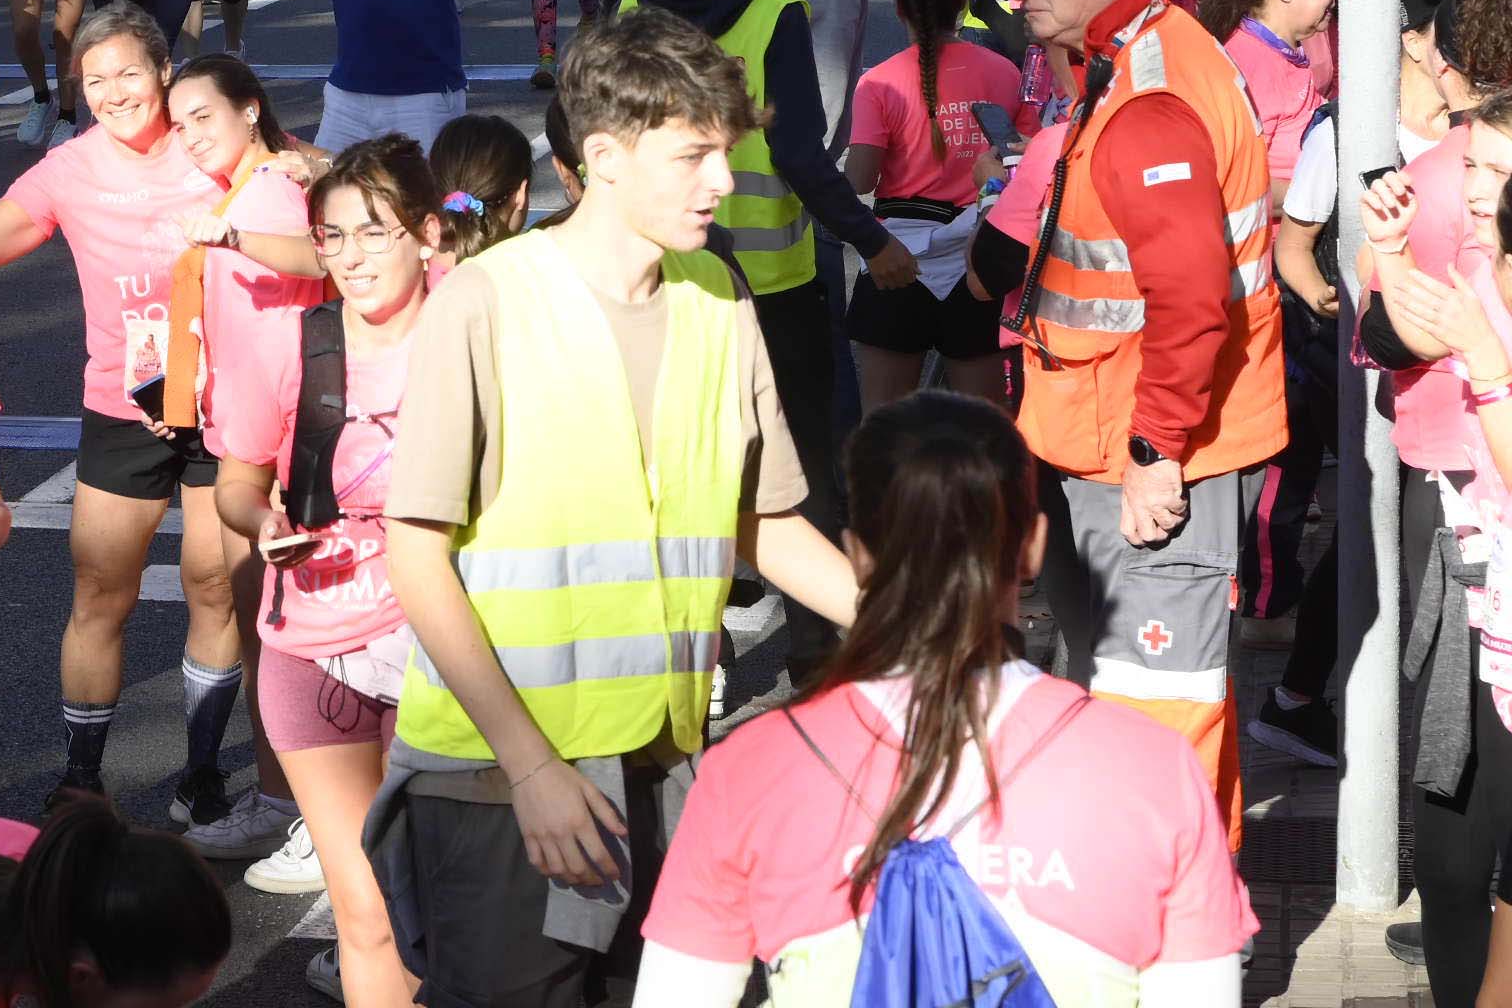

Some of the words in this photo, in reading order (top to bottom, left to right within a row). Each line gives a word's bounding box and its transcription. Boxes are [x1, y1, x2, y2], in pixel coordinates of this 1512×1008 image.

[943, 118, 965, 131] DE
[969, 116, 980, 129] L
[114, 273, 152, 299] TU
[843, 844, 1076, 891] CERA
